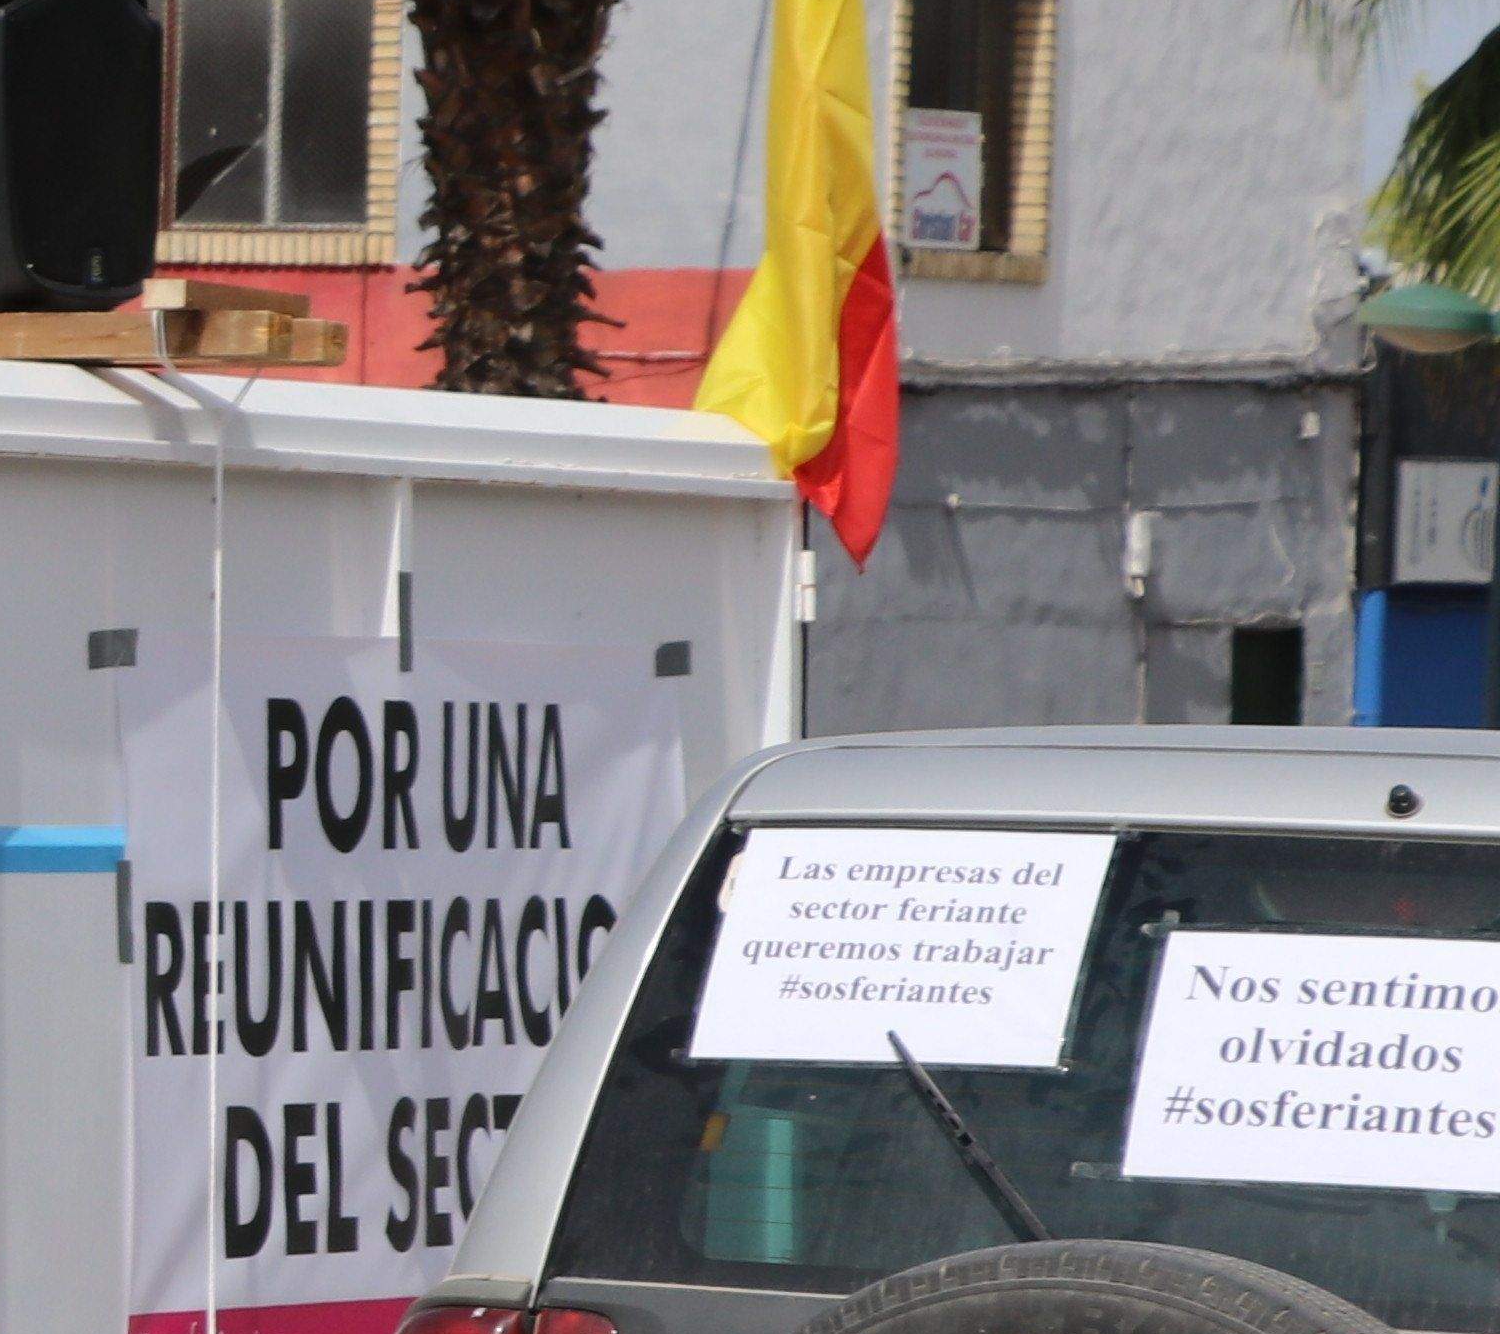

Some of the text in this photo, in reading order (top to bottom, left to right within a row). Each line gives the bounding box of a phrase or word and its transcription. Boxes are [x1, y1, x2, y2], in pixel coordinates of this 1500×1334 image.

[266, 696, 572, 854] POR UNA
[778, 855, 1064, 891] Las empresas del
[789, 896, 1027, 925] sector feriante
[741, 936, 1054, 972] queremos trabajar
[778, 974, 992, 1006] #sosferiantes
[1185, 964, 1279, 1004] Nos
[1220, 1028, 1463, 1072] olvidados
[1163, 1085, 1497, 1140] #sosferiantes
[223, 1104, 360, 1259] DEL
